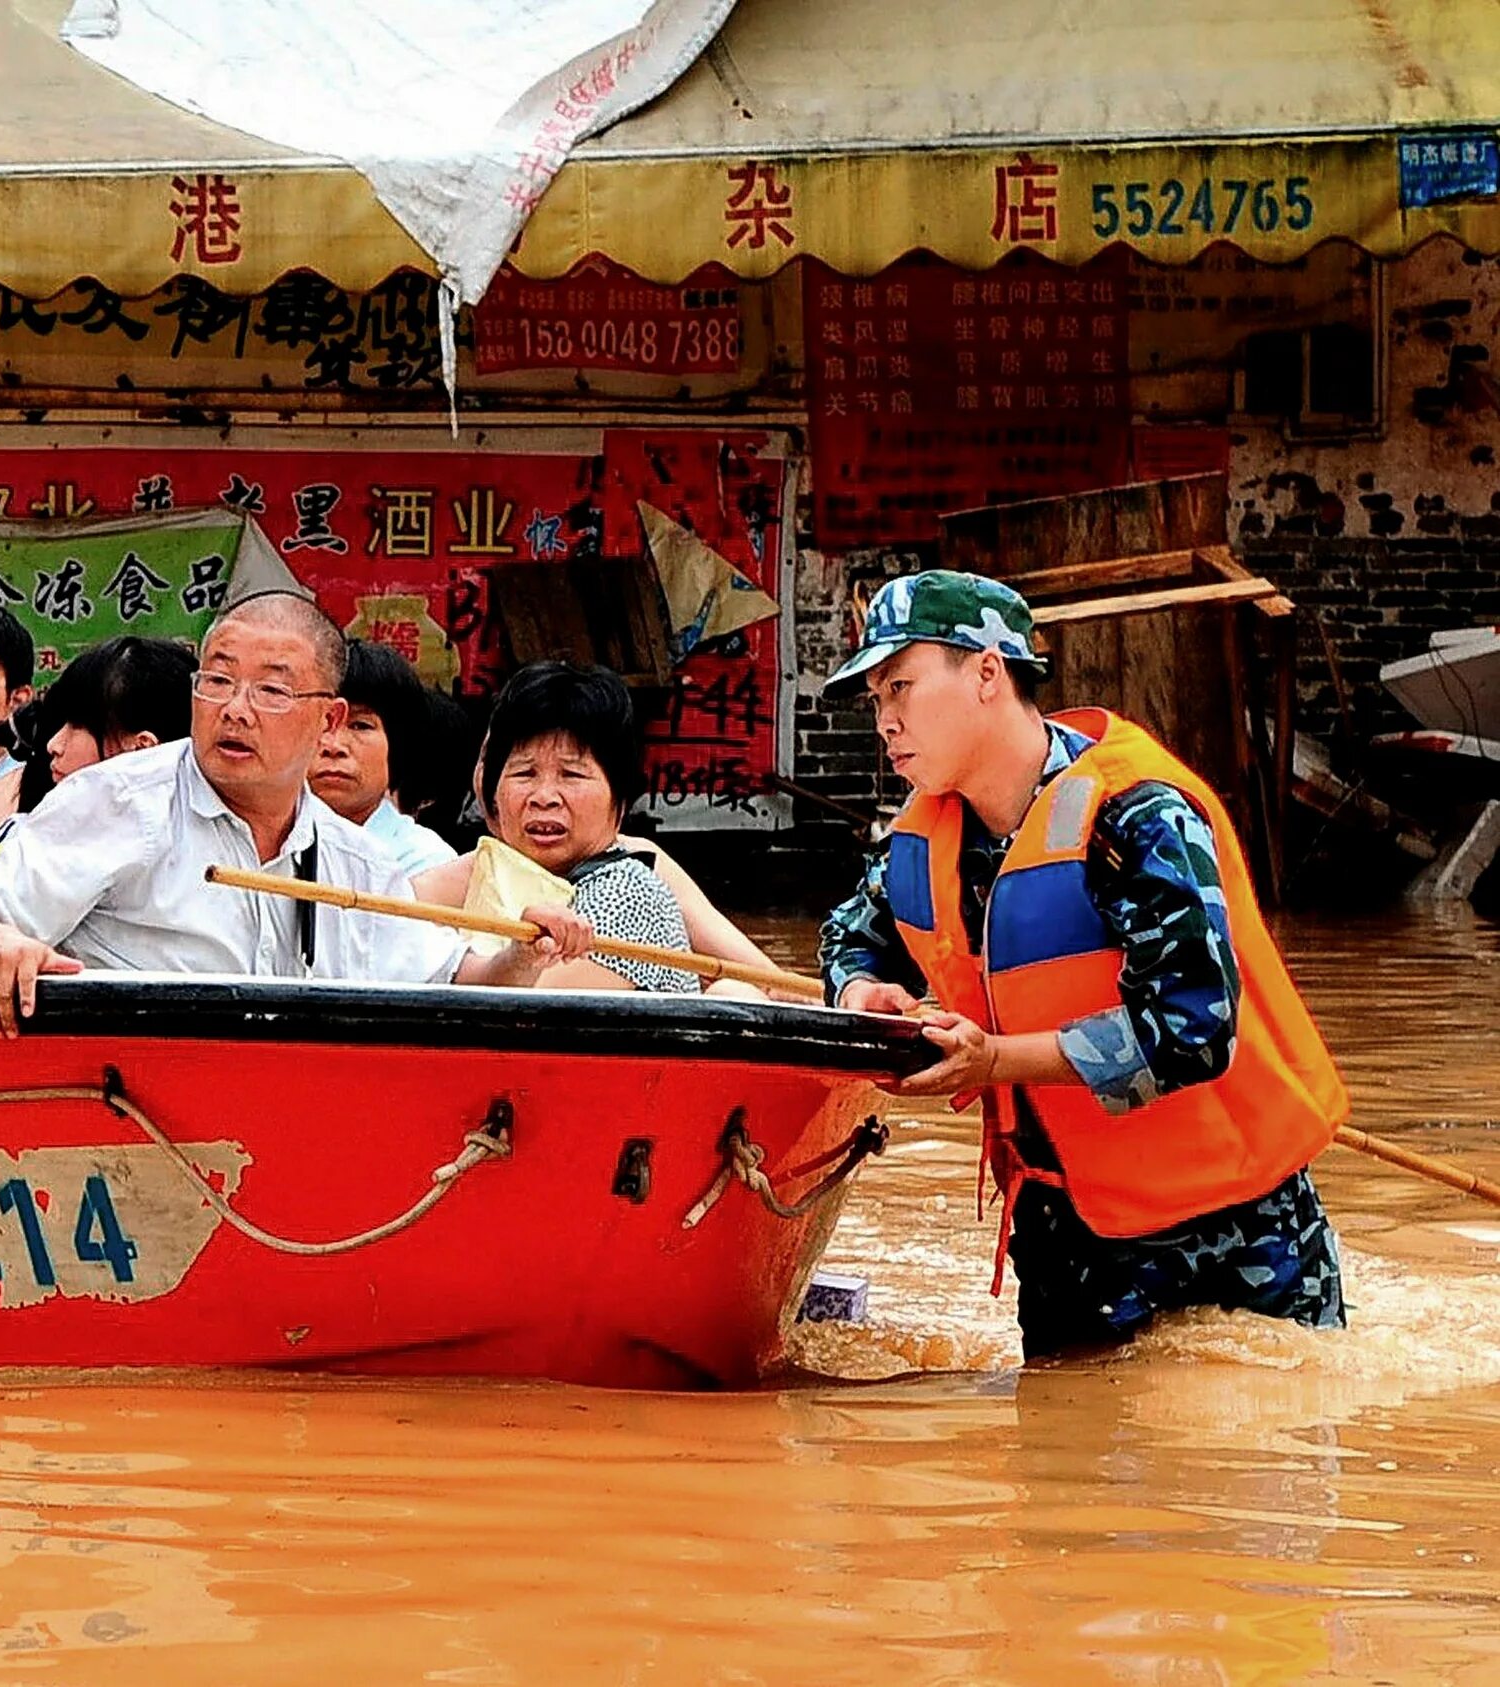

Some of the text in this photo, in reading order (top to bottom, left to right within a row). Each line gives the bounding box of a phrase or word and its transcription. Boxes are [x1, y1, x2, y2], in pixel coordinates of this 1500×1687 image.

[168, 174, 241, 265] 港
[723, 160, 795, 250] 杂
[990, 152, 1058, 244] 店
[1091, 177, 1314, 240] 5524765
